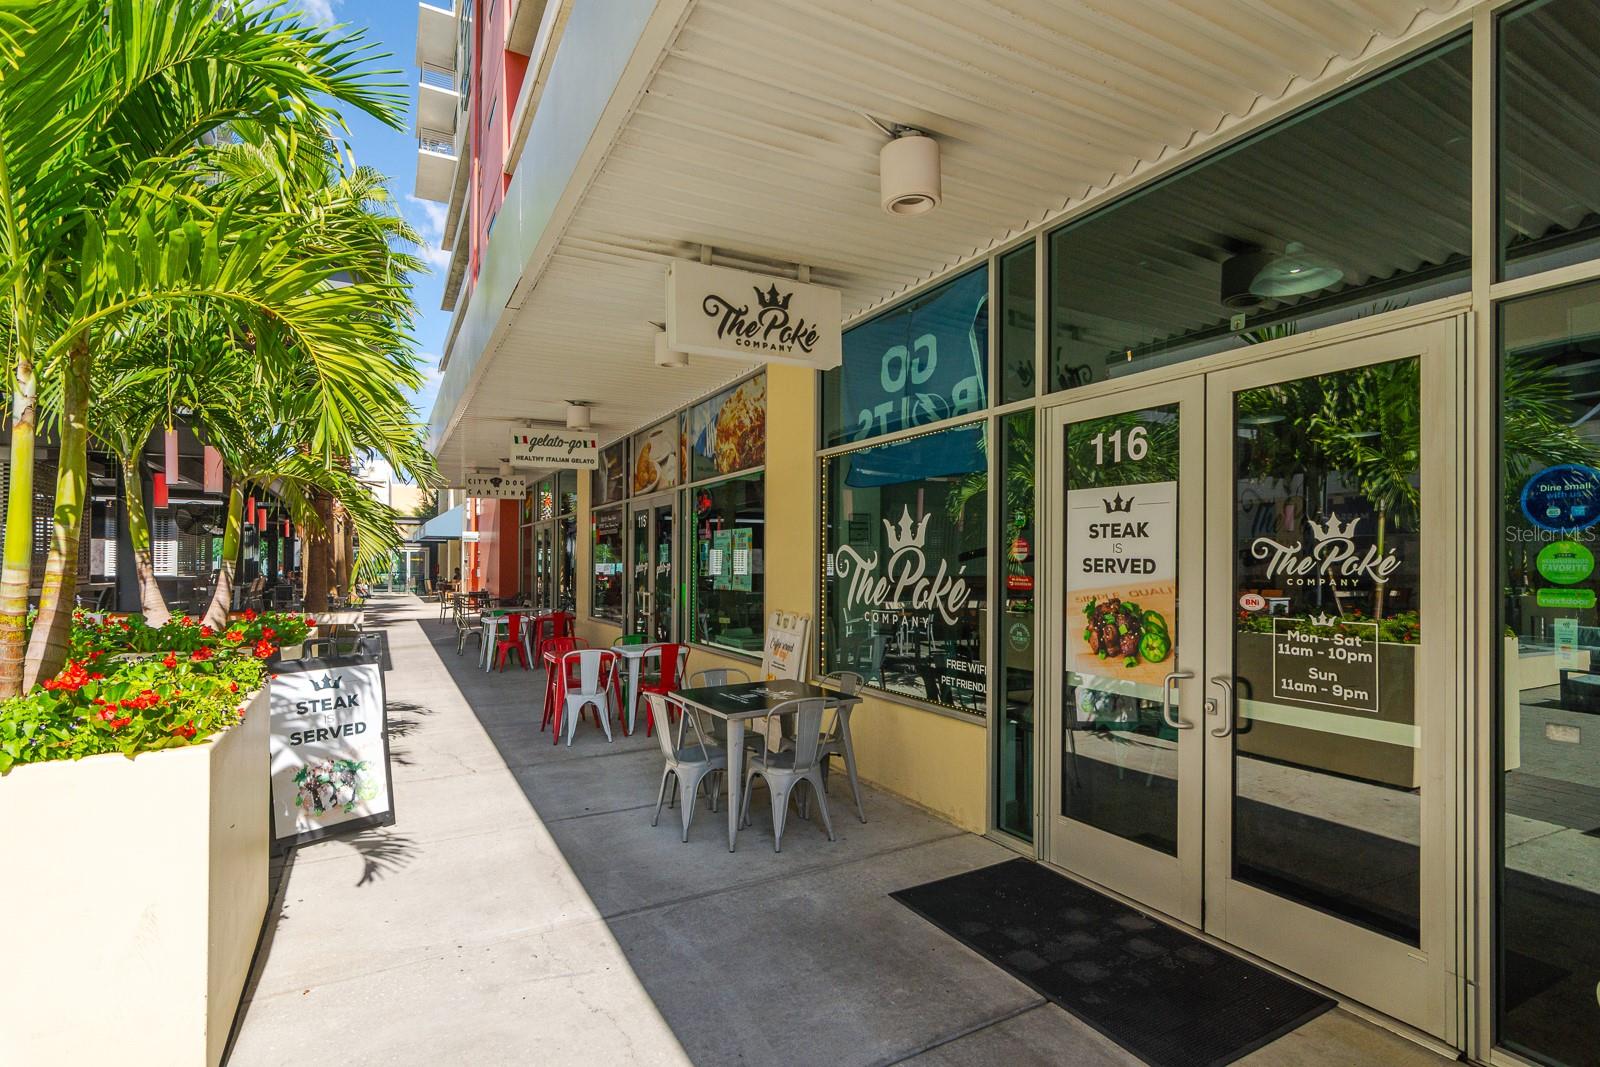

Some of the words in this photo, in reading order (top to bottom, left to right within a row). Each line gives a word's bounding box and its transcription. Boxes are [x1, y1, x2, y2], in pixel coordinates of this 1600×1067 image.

[703, 294, 761, 340] The
[758, 307, 820, 353] Poké
[735, 338, 793, 353] COMPANY
[529, 433, 583, 455] gelato-go
[1090, 426, 1148, 465] 116
[1540, 484, 1562, 492] Dine
[1564, 482, 1591, 491] small
[1088, 521, 1150, 539] STEAK
[1112, 542, 1123, 554] IS
[1082, 557, 1157, 575] SERVED
[1251, 537, 1317, 580] The
[1313, 537, 1402, 584] Poké
[835, 544, 891, 611] The
[887, 546, 971, 626] Poké
[1286, 578, 1359, 587] COMPANY
[1128, 586, 1173, 598] QUALI
[864, 611, 929, 629] COMPANY
[1287, 629, 1319, 643] Mon
[1333, 633, 1362, 647] Sat
[1278, 643, 1314, 657] 11am
[1328, 648, 1373, 664] 10pm
[946, 658, 967, 672] FREE
[967, 662, 987, 676] WIFI
[1308, 667, 1338, 682] Sun
[940, 675, 956, 686] PET
[956, 678, 987, 694] FRIENDL
[1281, 678, 1317, 693] 11am
[1332, 684, 1369, 701] 9pm
[295, 694, 360, 715] STEAK
[324, 713, 336, 725] IS
[290, 721, 367, 746] SERVED
